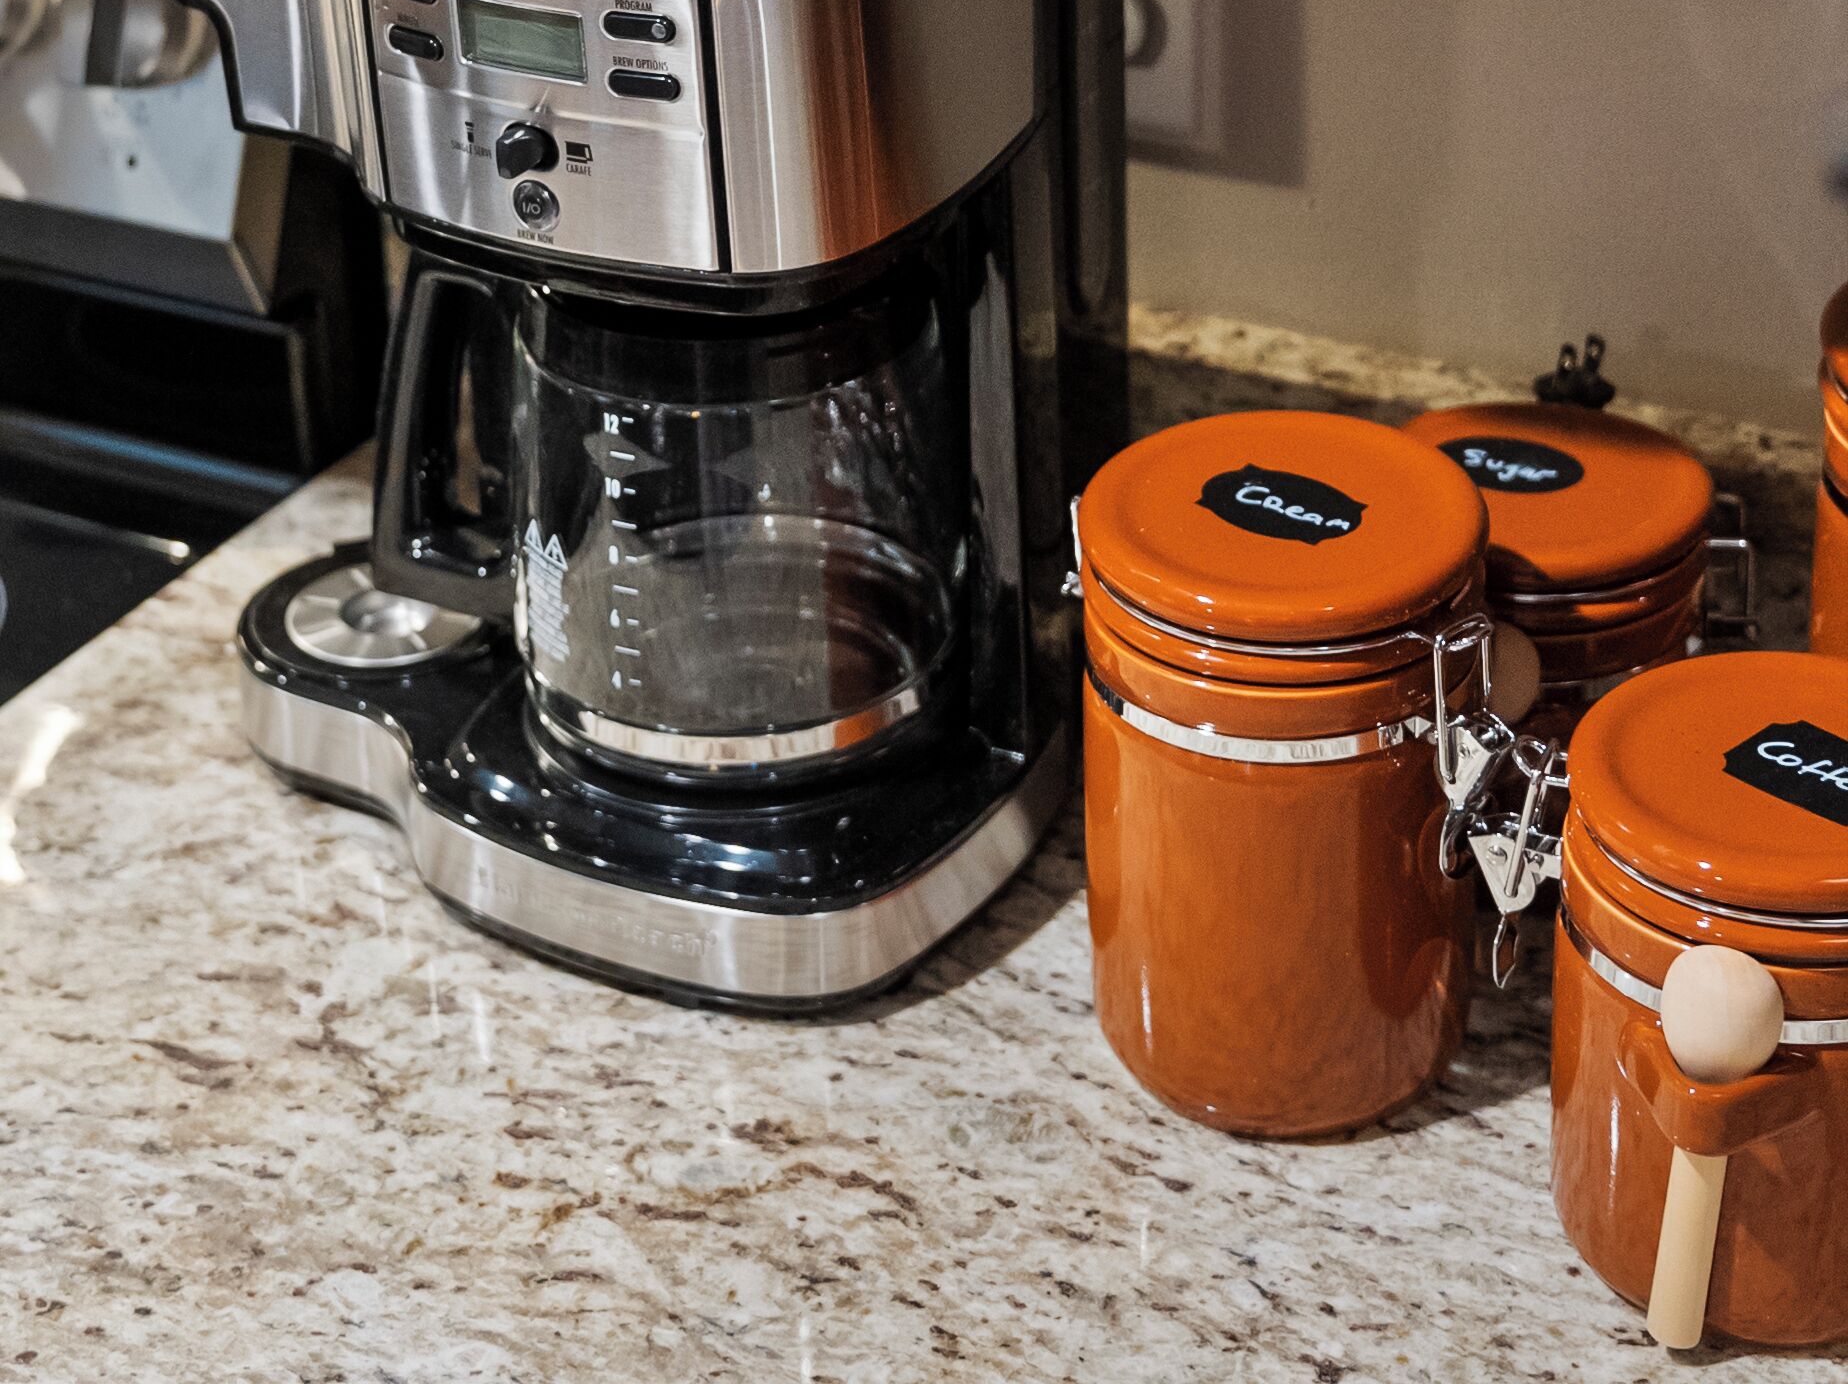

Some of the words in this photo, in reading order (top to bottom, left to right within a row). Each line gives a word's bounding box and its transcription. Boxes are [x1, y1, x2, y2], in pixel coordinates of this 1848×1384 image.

[614, 0, 653, 12] PROGRAM
[613, 56, 634, 67] BREW
[636, 58, 668, 71] OPTIONS
[566, 162, 592, 176] CARAFE
[517, 229, 536, 241] BREW
[537, 232, 554, 244] NOW
[604, 413, 619, 434] 12
[1463, 448, 1558, 482] Sugar
[605, 477, 621, 499] 10
